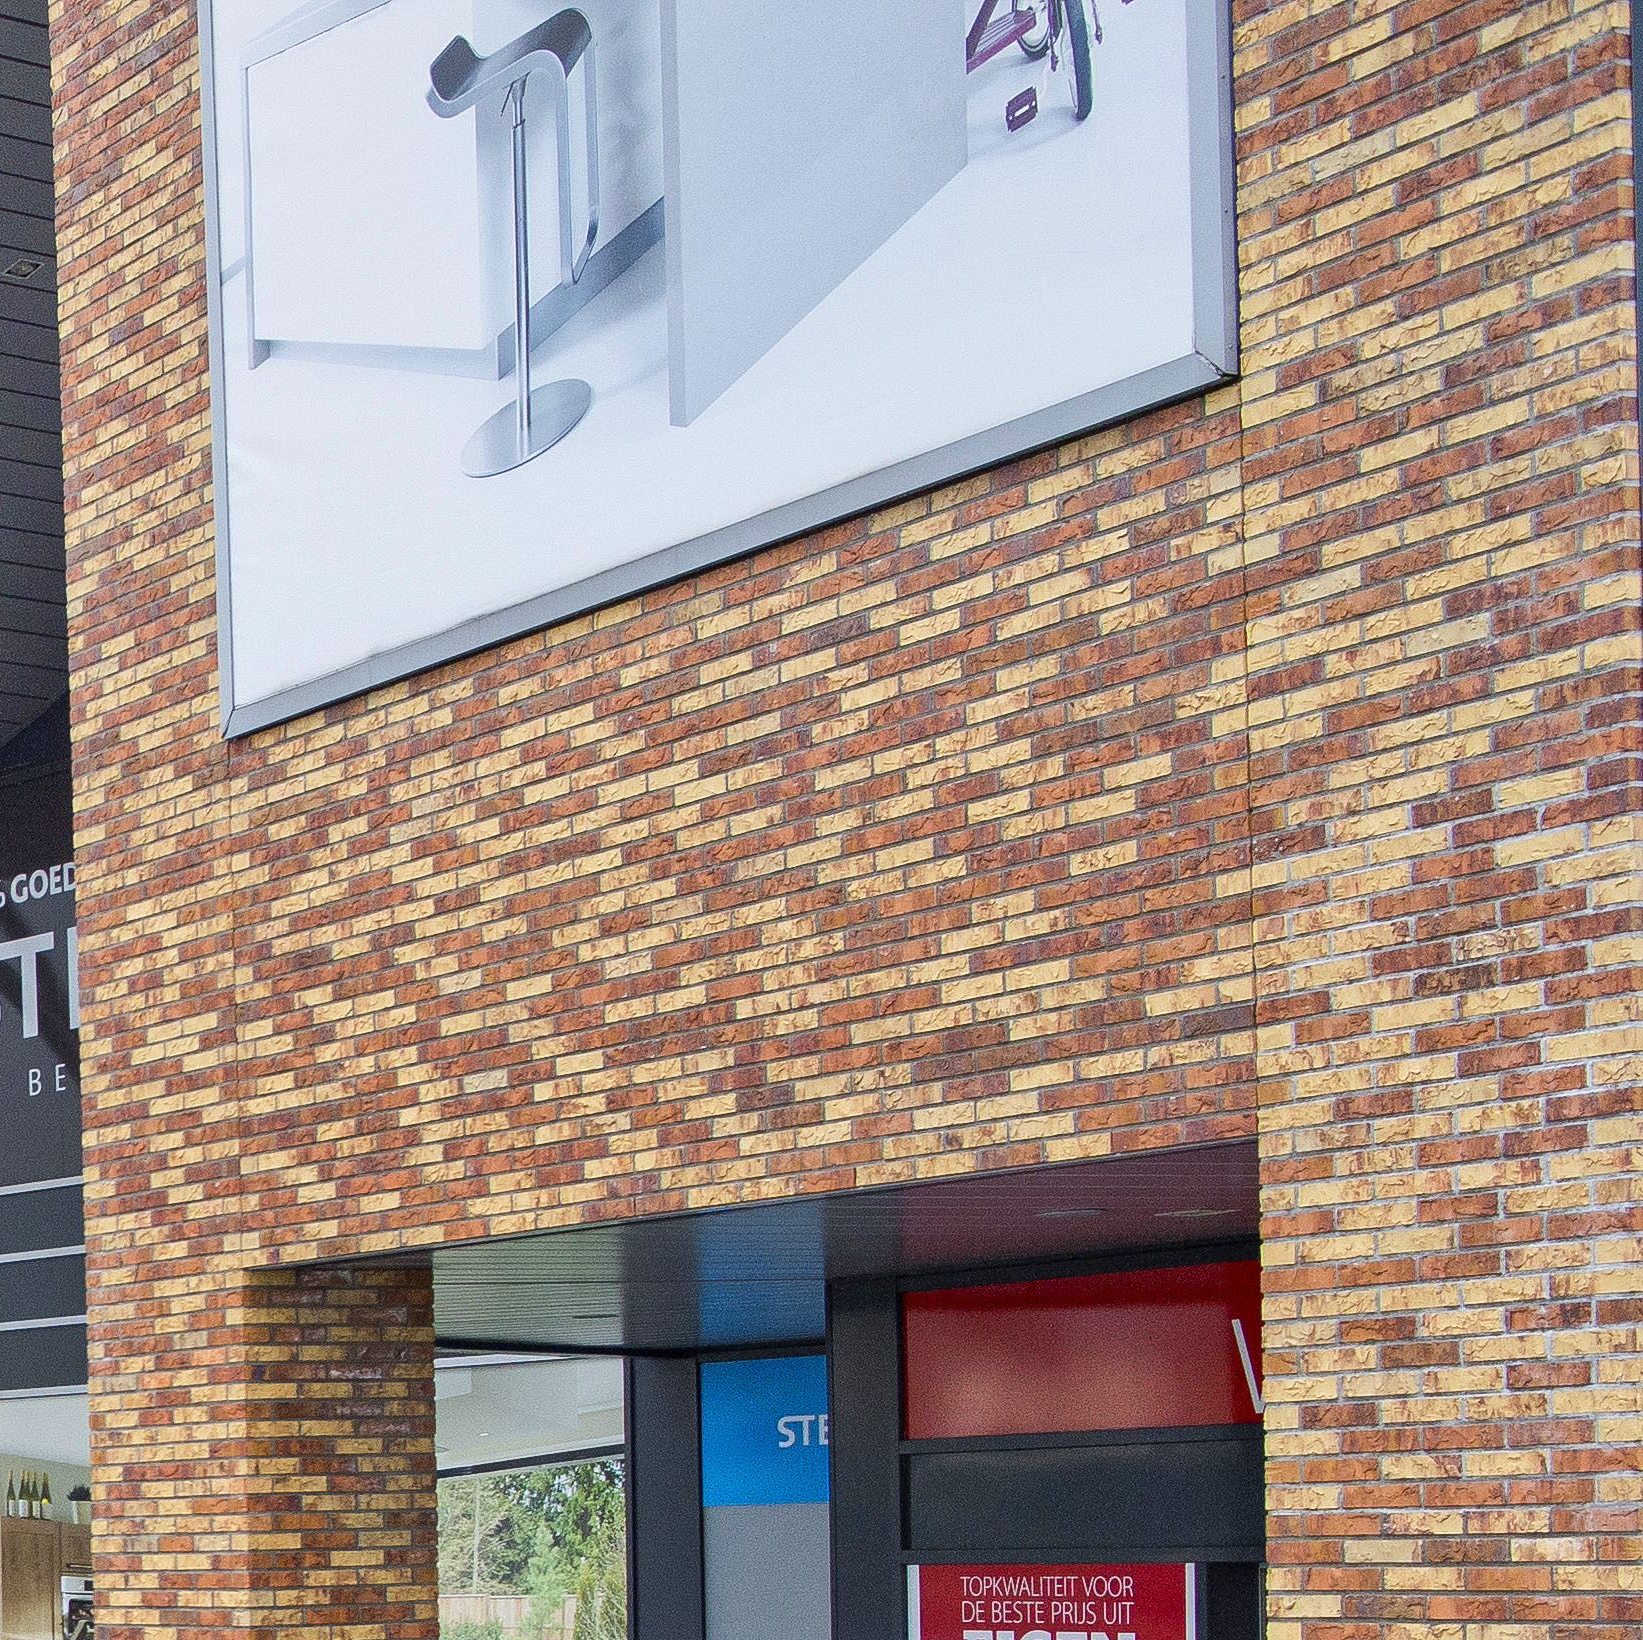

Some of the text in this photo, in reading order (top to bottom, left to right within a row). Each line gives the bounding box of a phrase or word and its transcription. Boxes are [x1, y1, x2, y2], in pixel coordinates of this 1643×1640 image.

[10, 862, 76, 904] GOED
[28, 1063, 66, 1097] BE
[960, 1576, 1134, 1597] TOPKWALITEIT VOOR
[961, 1601, 1135, 1625] DE BESTE PRIJS UIT
